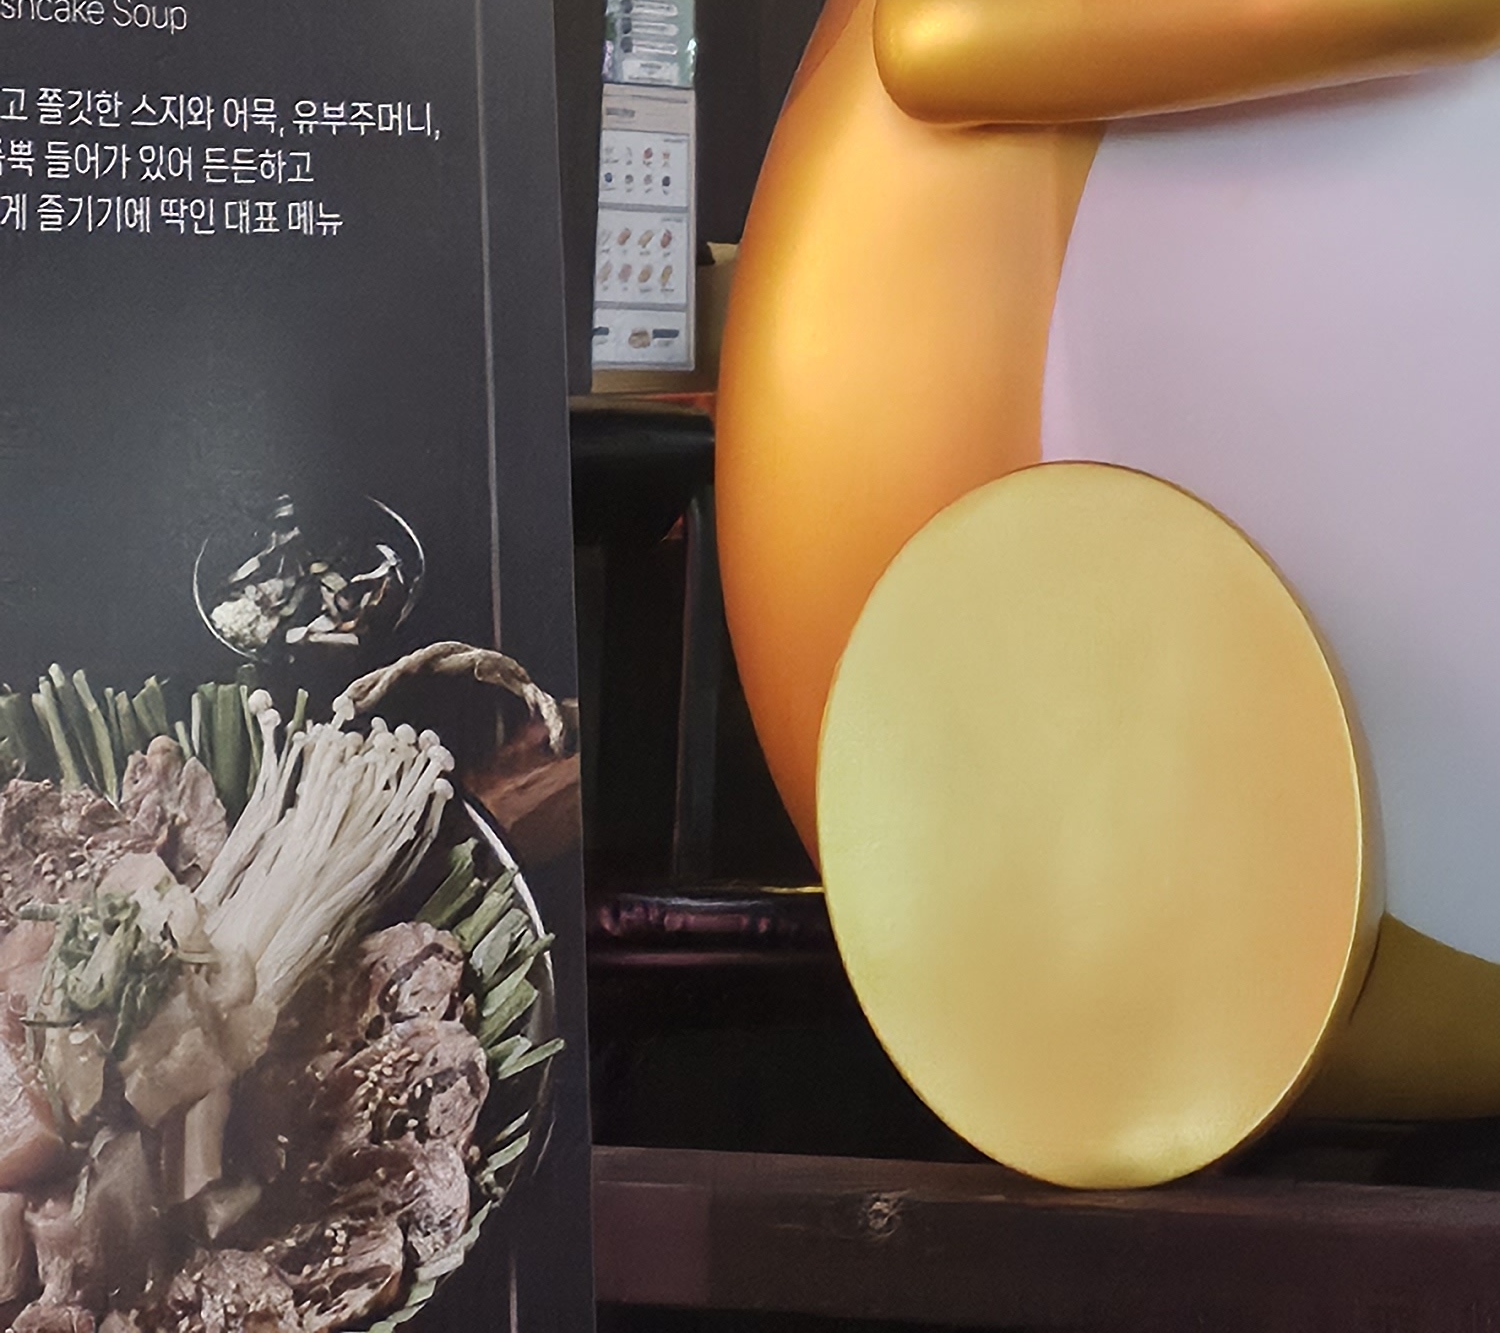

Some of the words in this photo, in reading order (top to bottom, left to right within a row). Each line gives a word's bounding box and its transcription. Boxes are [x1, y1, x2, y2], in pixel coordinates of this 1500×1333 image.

[36, 87, 124, 128] 쫄깃한
[130, 94, 215, 131] 스지와
[224, 97, 285, 137] 어묵,
[293, 99, 441, 141] 유부주머니,
[45, 140, 132, 180] 들어가
[139, 144, 193, 182] 있어
[203, 146, 314, 185] 든든하고
[36, 193, 151, 235] 즐기기에
[161, 198, 215, 235] 딱인
[225, 199, 281, 234] 대표
[288, 200, 343, 237] 메뉴
